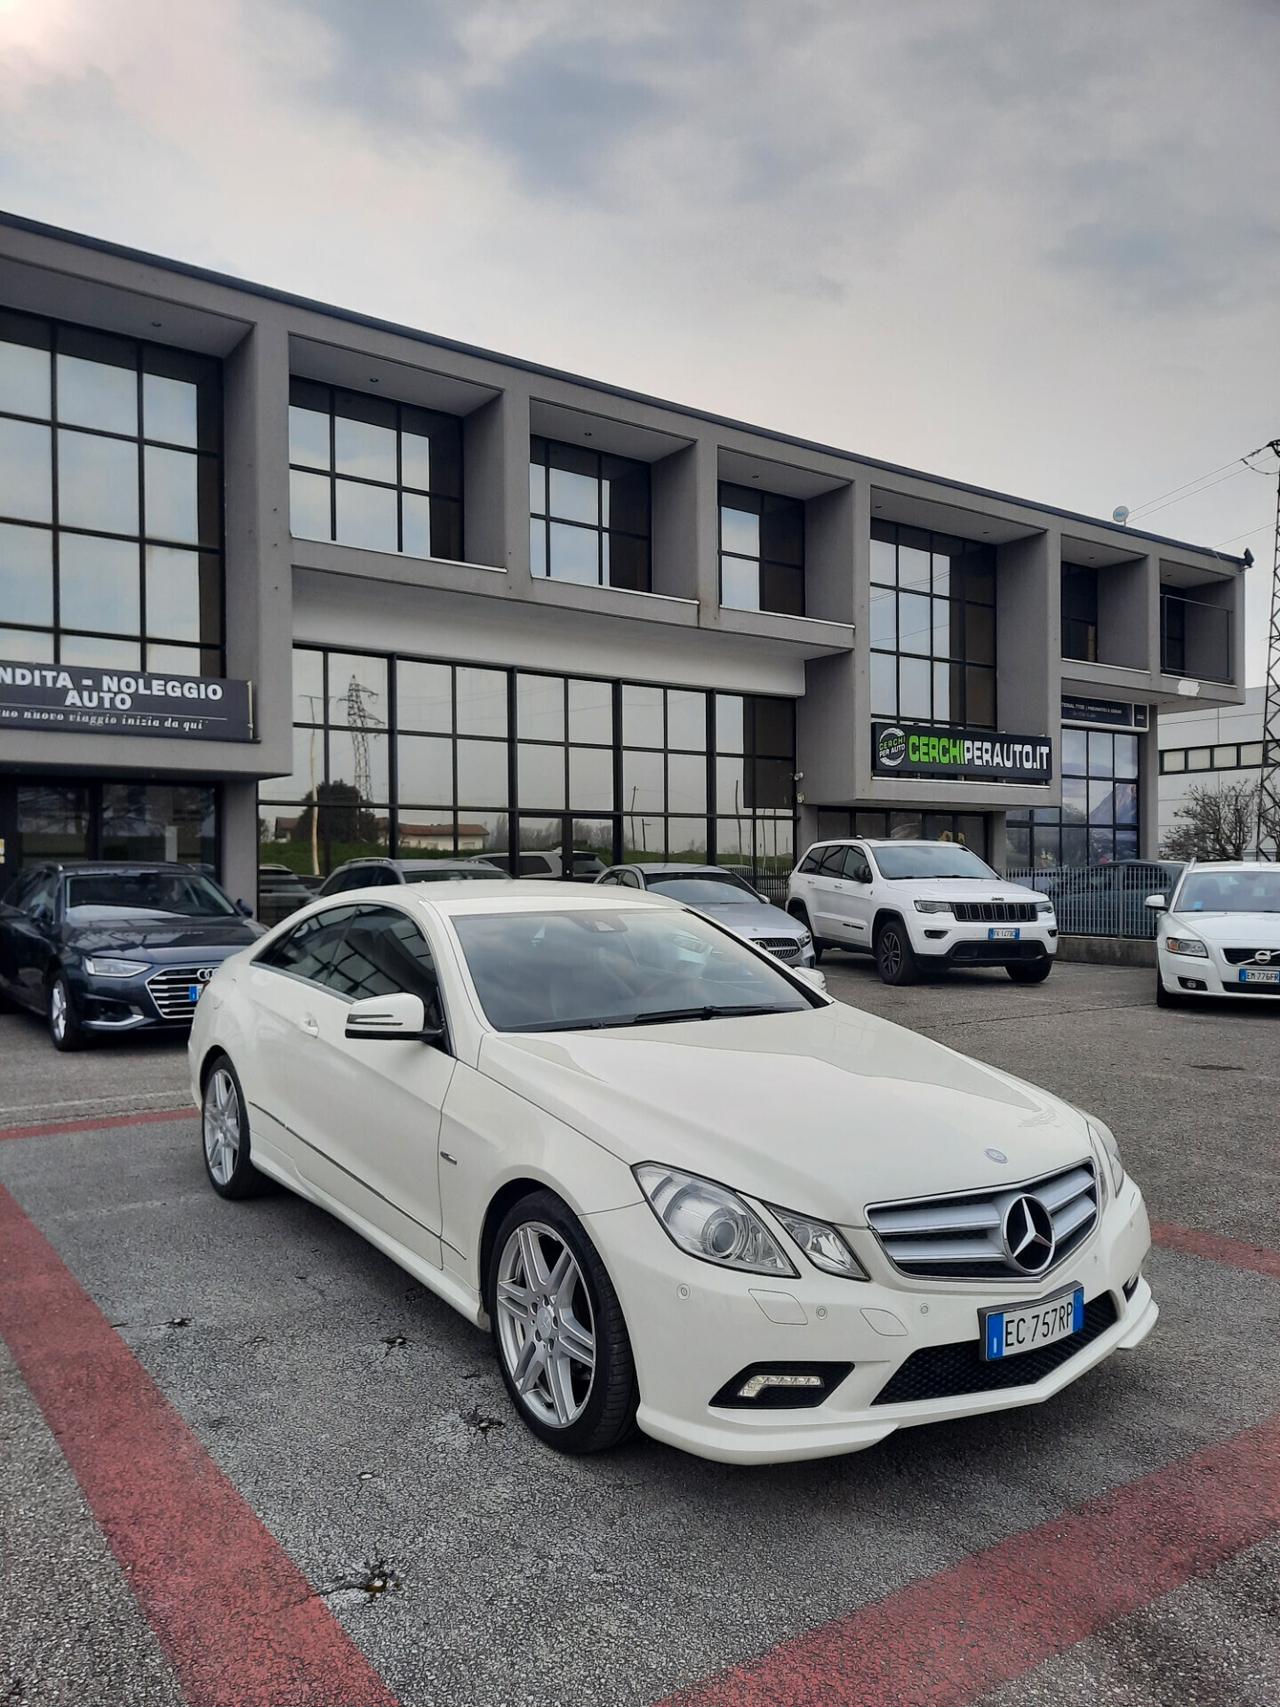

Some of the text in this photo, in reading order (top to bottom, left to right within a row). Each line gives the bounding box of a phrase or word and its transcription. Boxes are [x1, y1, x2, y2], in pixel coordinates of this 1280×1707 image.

[65, 690, 132, 709] AUTO
[102, 676, 223, 700] NOLEGGIO
[0, 708, 18, 718] uo
[23, 709, 64, 720] nuovo
[69, 713, 117, 726] viaggio
[122, 715, 160, 727] inizia
[164, 718, 181, 728] da
[909, 735, 1050, 770] CERCHIPERAUTO.IT
[1005, 1318, 1026, 1347] EC
[1031, 1302, 1073, 1342] 757RP
